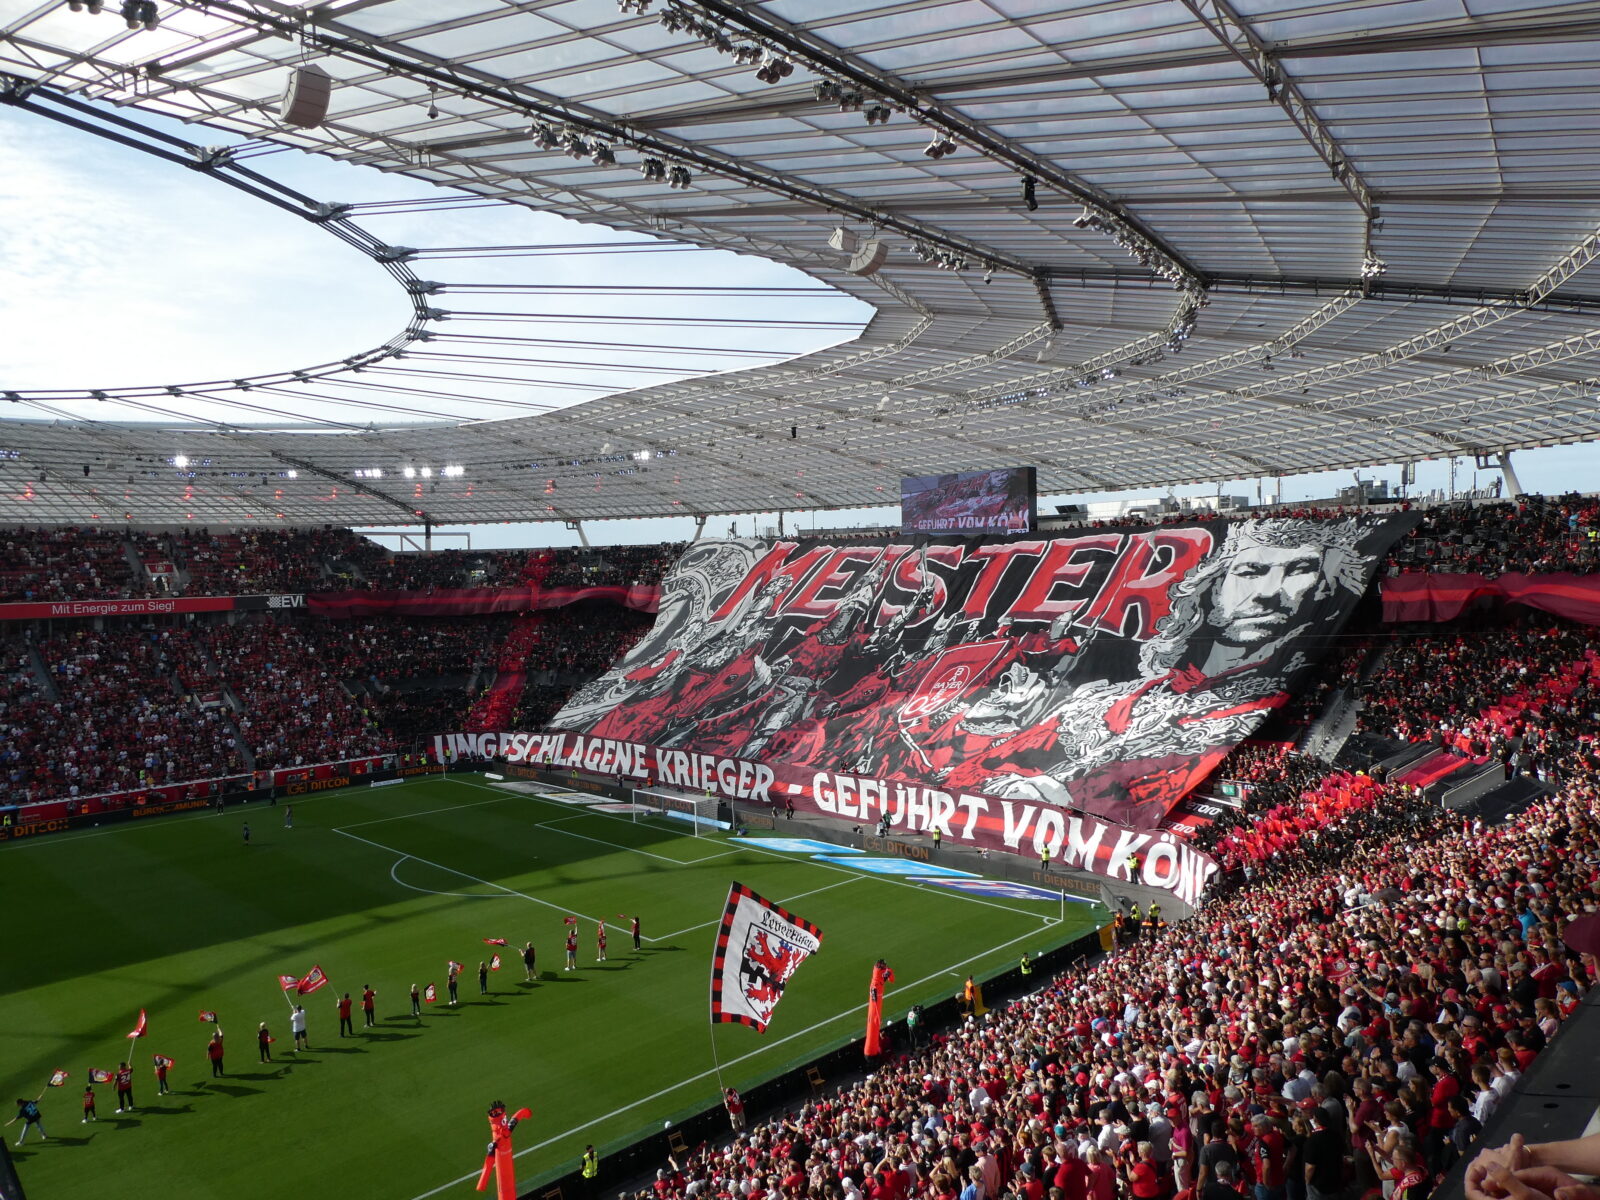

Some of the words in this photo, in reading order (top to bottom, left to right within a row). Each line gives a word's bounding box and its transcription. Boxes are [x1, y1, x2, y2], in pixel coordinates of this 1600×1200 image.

[52, 605, 70, 614] Mit
[74, 603, 118, 616] Energie
[121, 603, 145, 612] zum
[148, 601, 175, 613] Sieg!
[708, 527, 1213, 642] MEISTER
[656, 748, 774, 802] KRIEGER
[813, 771, 988, 840] GEFÜHRT
[1001, 800, 1108, 872] VOM
[886, 840, 929, 860] DITCON
